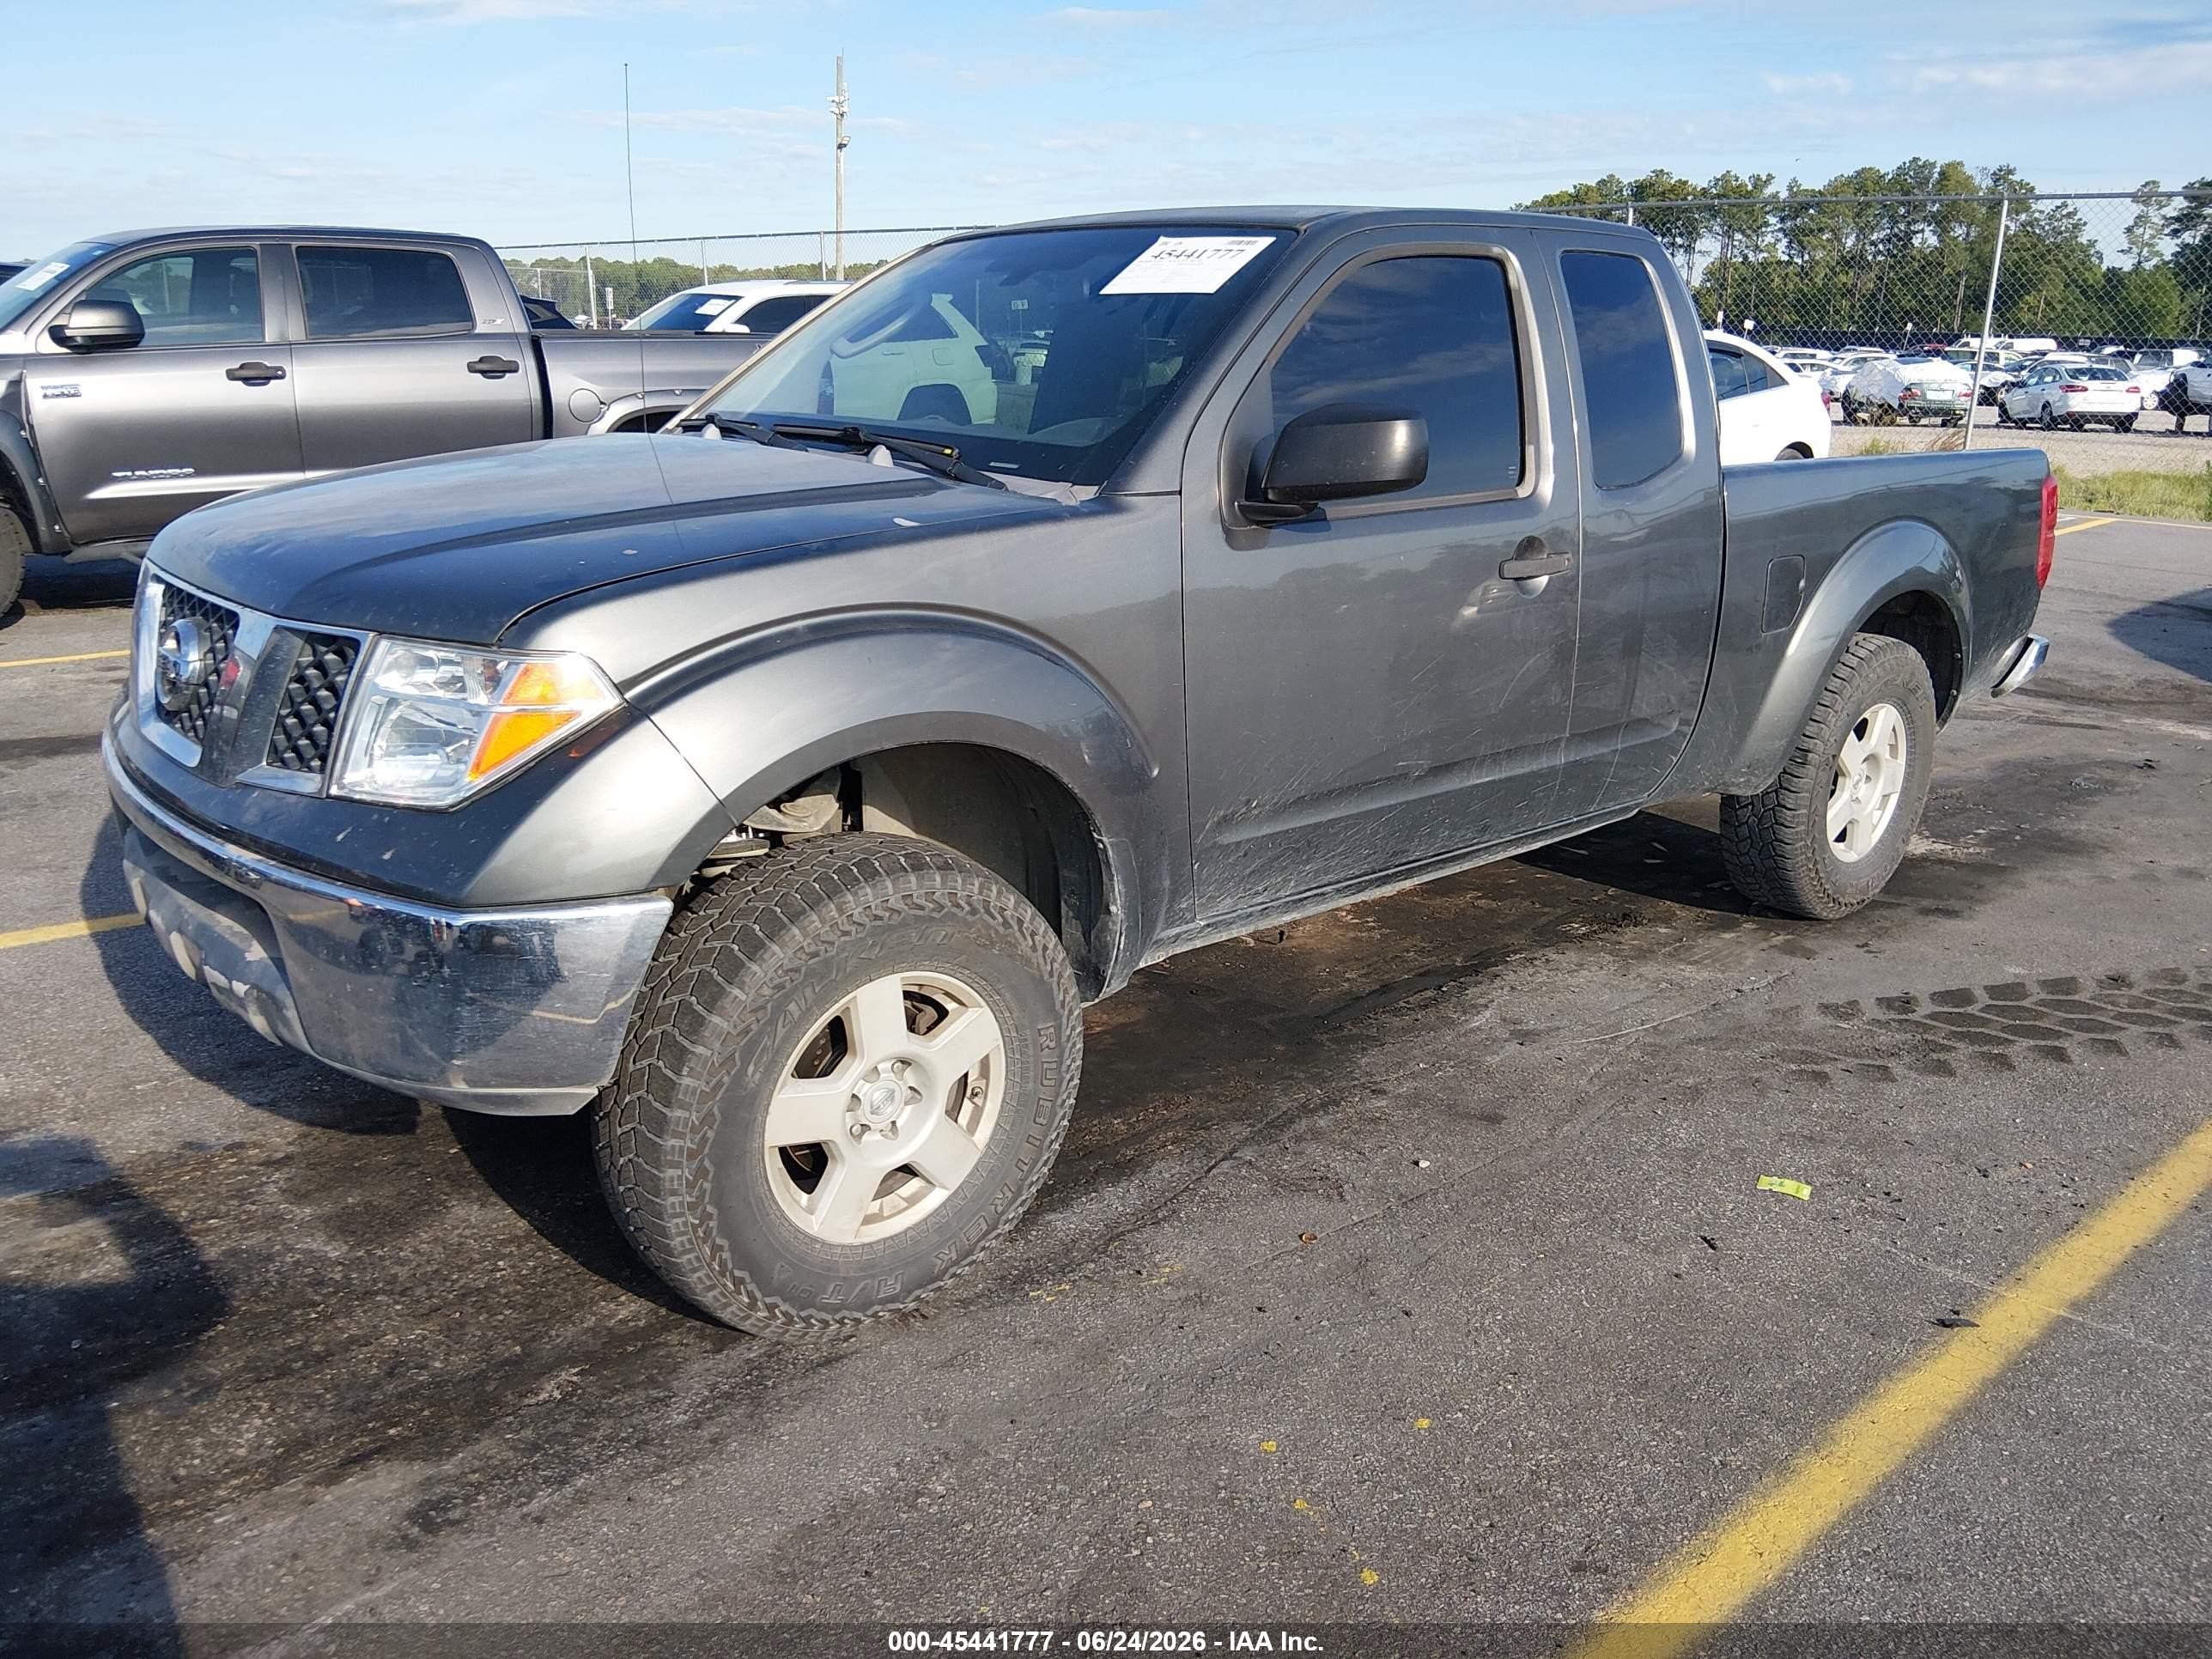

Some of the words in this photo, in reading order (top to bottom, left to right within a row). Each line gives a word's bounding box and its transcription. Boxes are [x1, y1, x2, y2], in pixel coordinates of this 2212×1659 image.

[1151, 248, 1246, 260] 45441777
[933, 1024, 1060, 1274] RUBITREK
[817, 1271, 905, 1304] A/T
